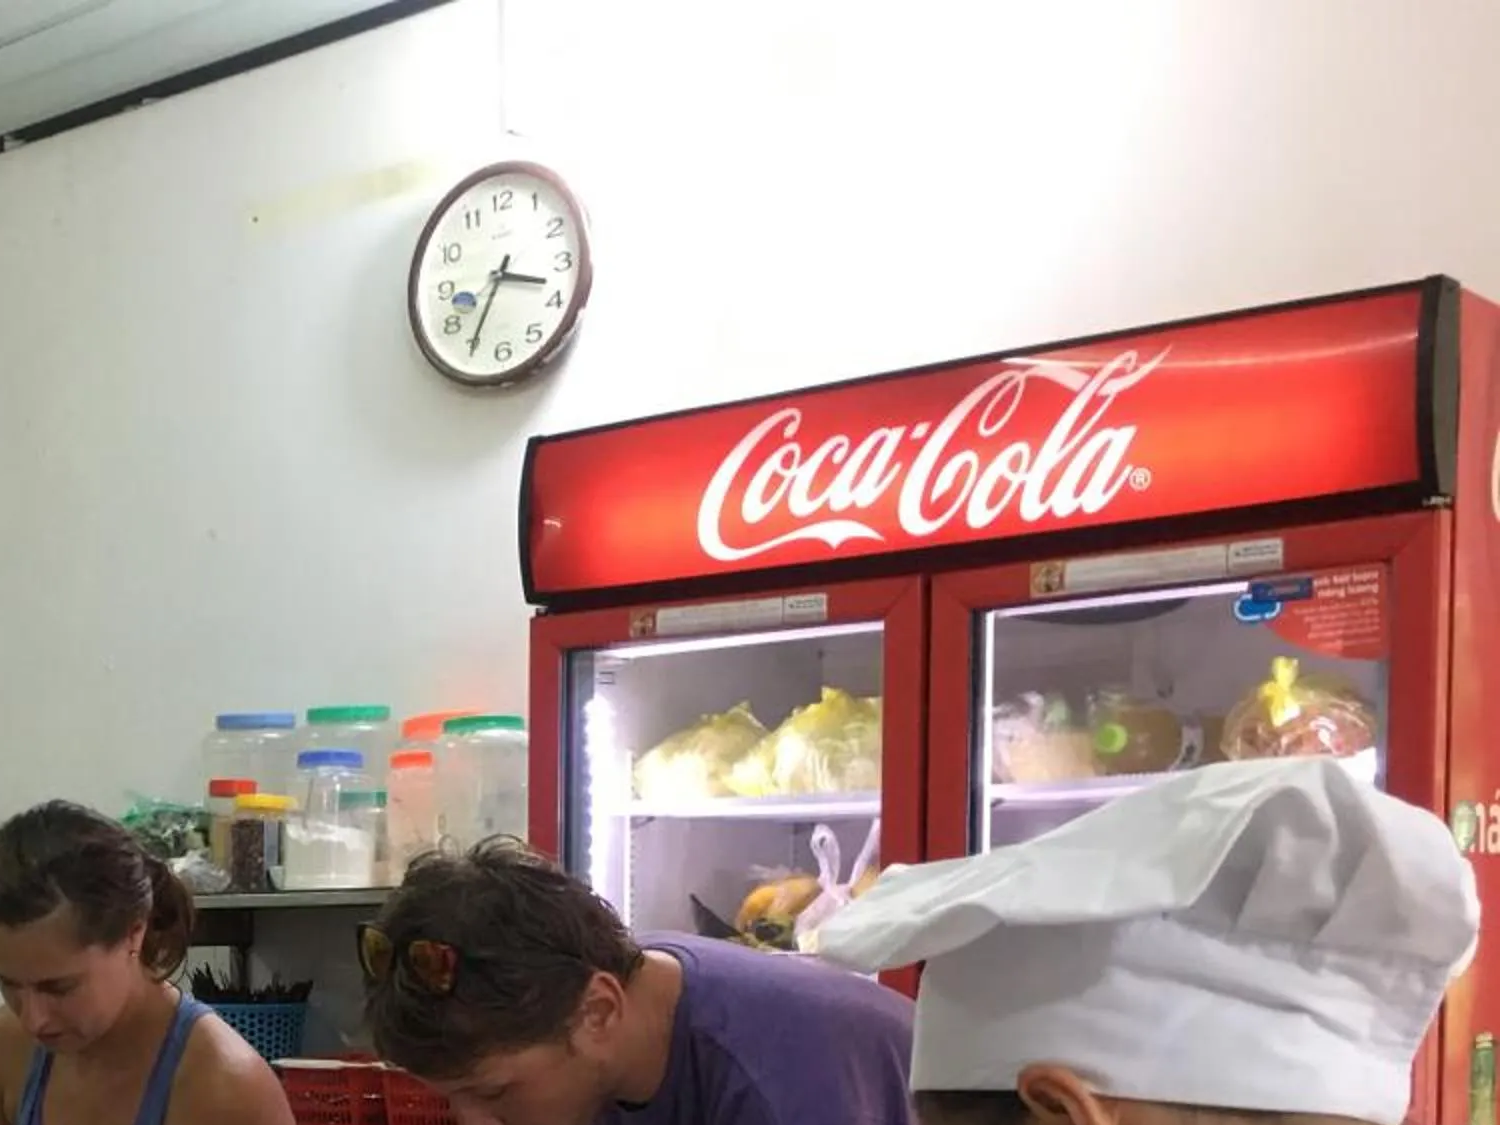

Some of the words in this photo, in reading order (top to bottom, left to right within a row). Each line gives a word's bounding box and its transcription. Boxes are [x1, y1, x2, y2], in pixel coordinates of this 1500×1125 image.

[492, 190, 514, 213] 12
[532, 192, 539, 212] 1
[465, 209, 482, 230] 11
[545, 217, 564, 239] 2
[442, 242, 462, 264] 10
[554, 251, 572, 272] 3
[438, 280, 456, 301] 9
[545, 290, 563, 309] 4
[444, 315, 462, 335] 8
[525, 323, 543, 343] 5
[494, 341, 513, 362] 6
[697, 343, 1173, 562] Coca-Cola
